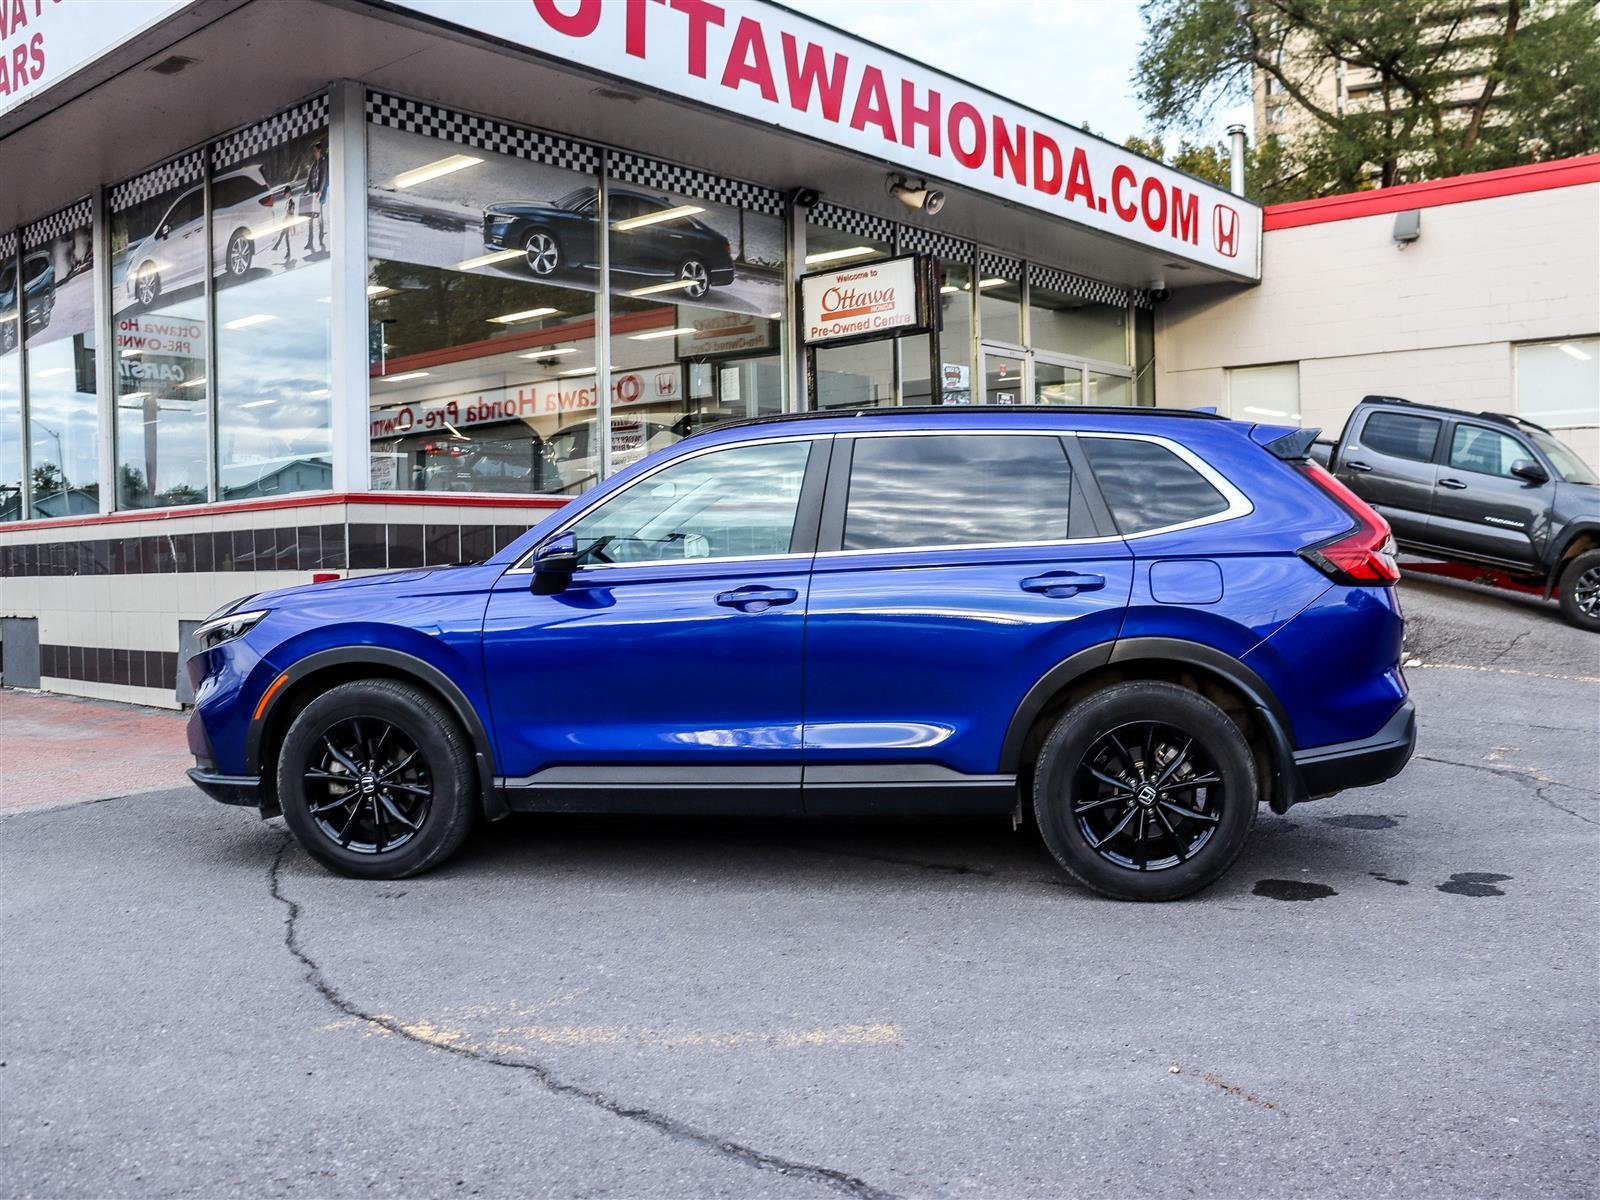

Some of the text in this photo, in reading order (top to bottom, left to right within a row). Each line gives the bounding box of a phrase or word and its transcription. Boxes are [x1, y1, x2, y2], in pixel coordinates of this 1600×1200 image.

[0, 32, 45, 96] ARS
[836, 270, 878, 283] Welcome to
[822, 287, 895, 311] Ottawa
[811, 313, 911, 338] Pre-Owned Centre
